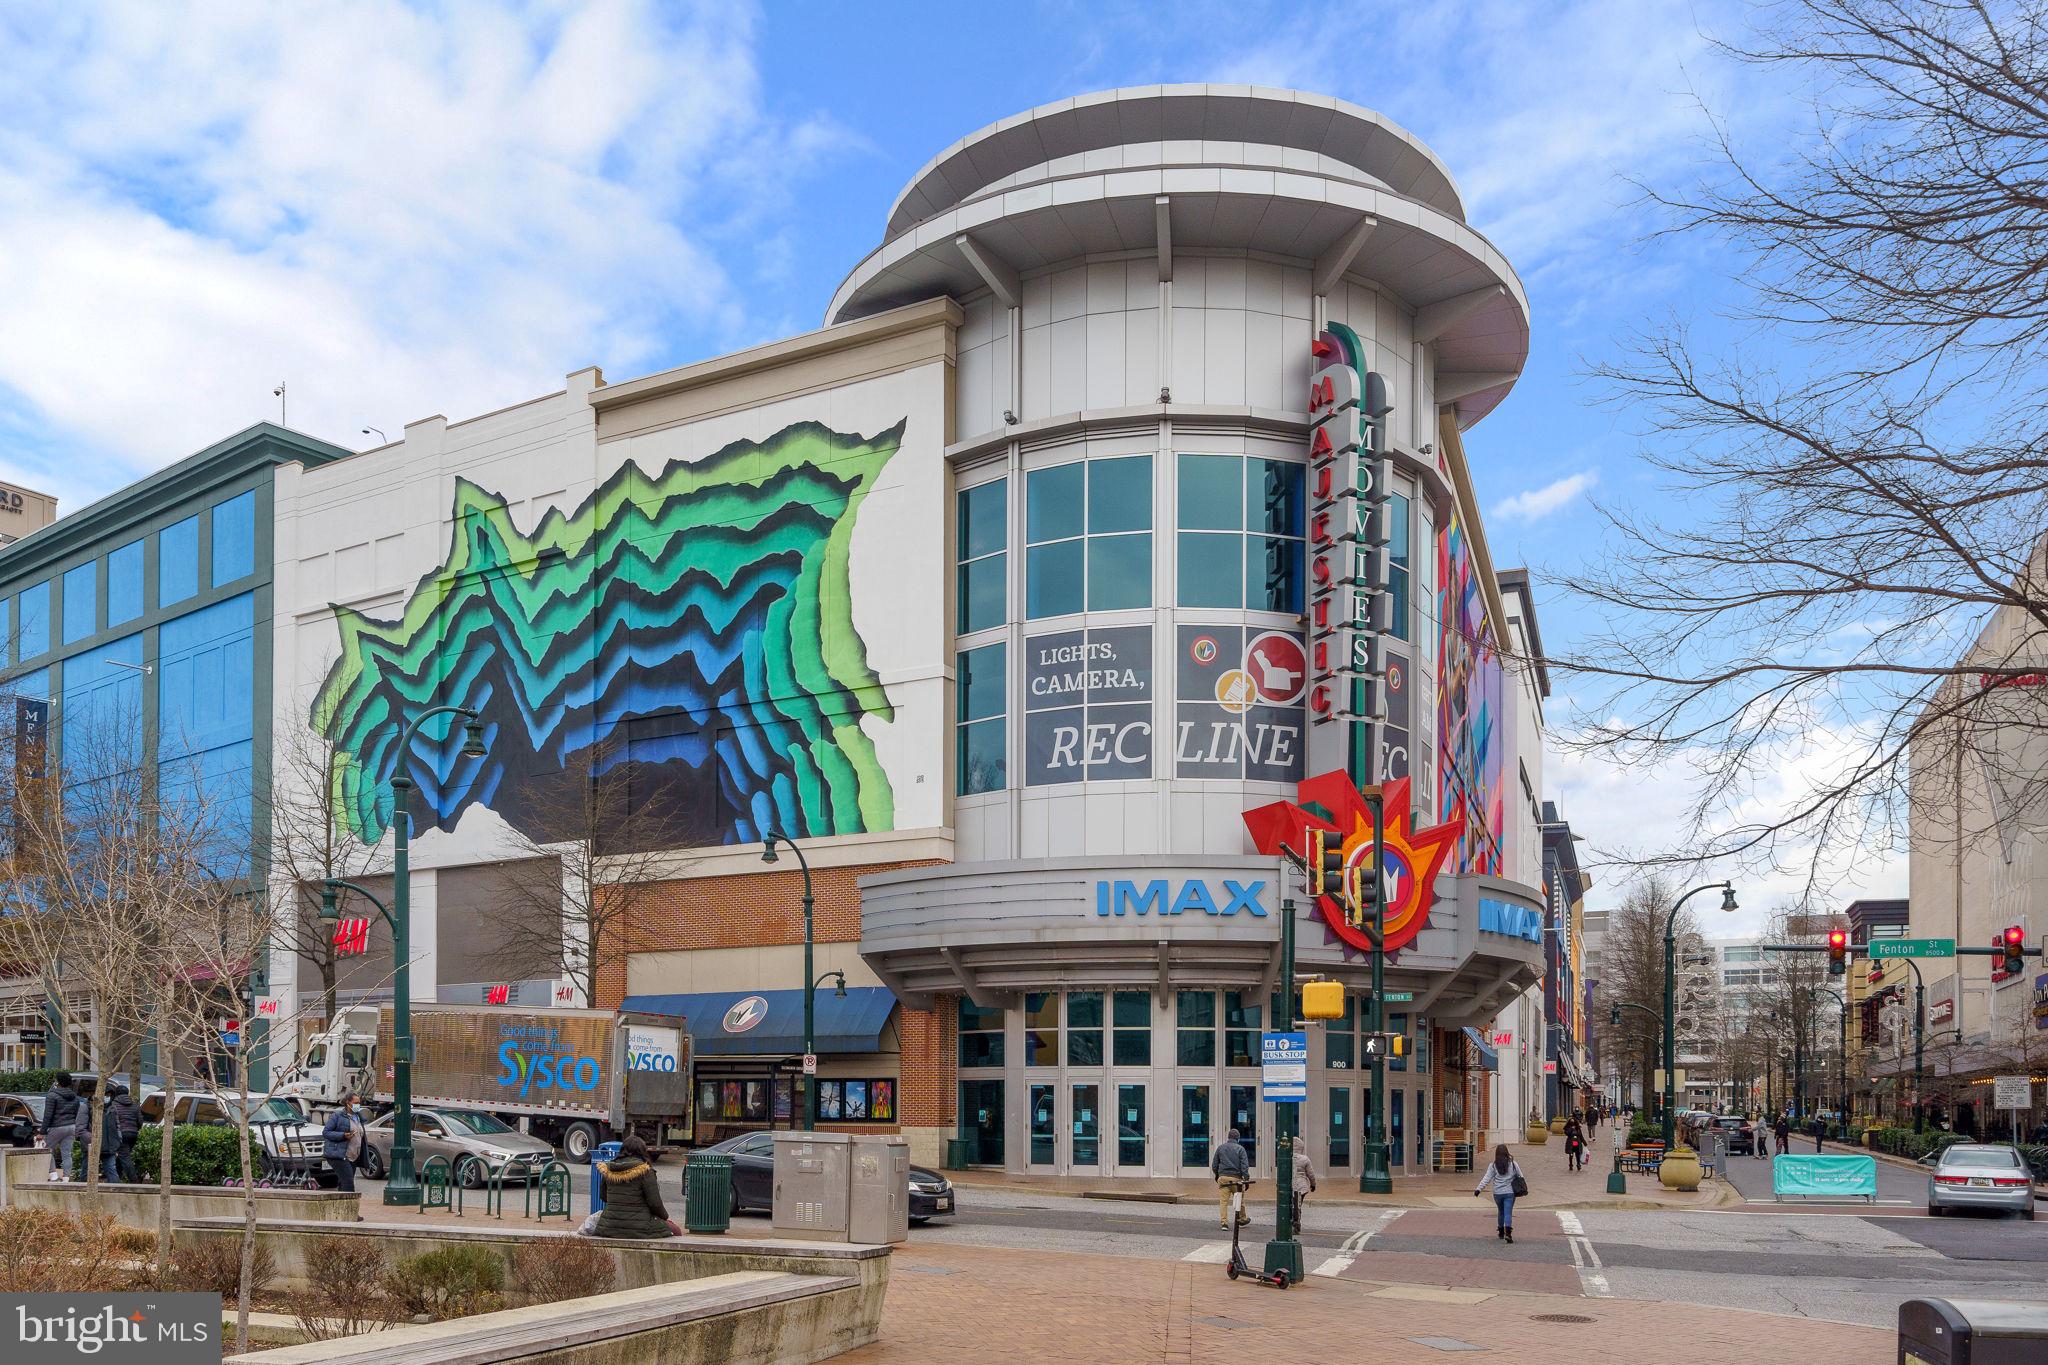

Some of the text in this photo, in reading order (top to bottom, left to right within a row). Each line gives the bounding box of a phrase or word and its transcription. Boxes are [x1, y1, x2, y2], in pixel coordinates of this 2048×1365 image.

[1309, 375, 1334, 714] MAJESTIC
[1354, 425, 1373, 667] MOVIES
[1040, 642, 1117, 666] LIGHTS,
[1032, 668, 1145, 696] CAMERA,
[1097, 879, 1269, 917] IMAX
[1478, 897, 1544, 944] IMAX
[332, 918, 370, 956] H&M
[1880, 940, 1937, 954] Fenton St
[487, 985, 509, 1005] H&M
[556, 986, 574, 1002] H&M
[259, 1000, 277, 1015] H&M
[500, 1023, 558, 1039] Good things
[637, 1034, 653, 1045] things
[522, 1040, 547, 1051] come
[1332, 1060, 1346, 1068] 900
